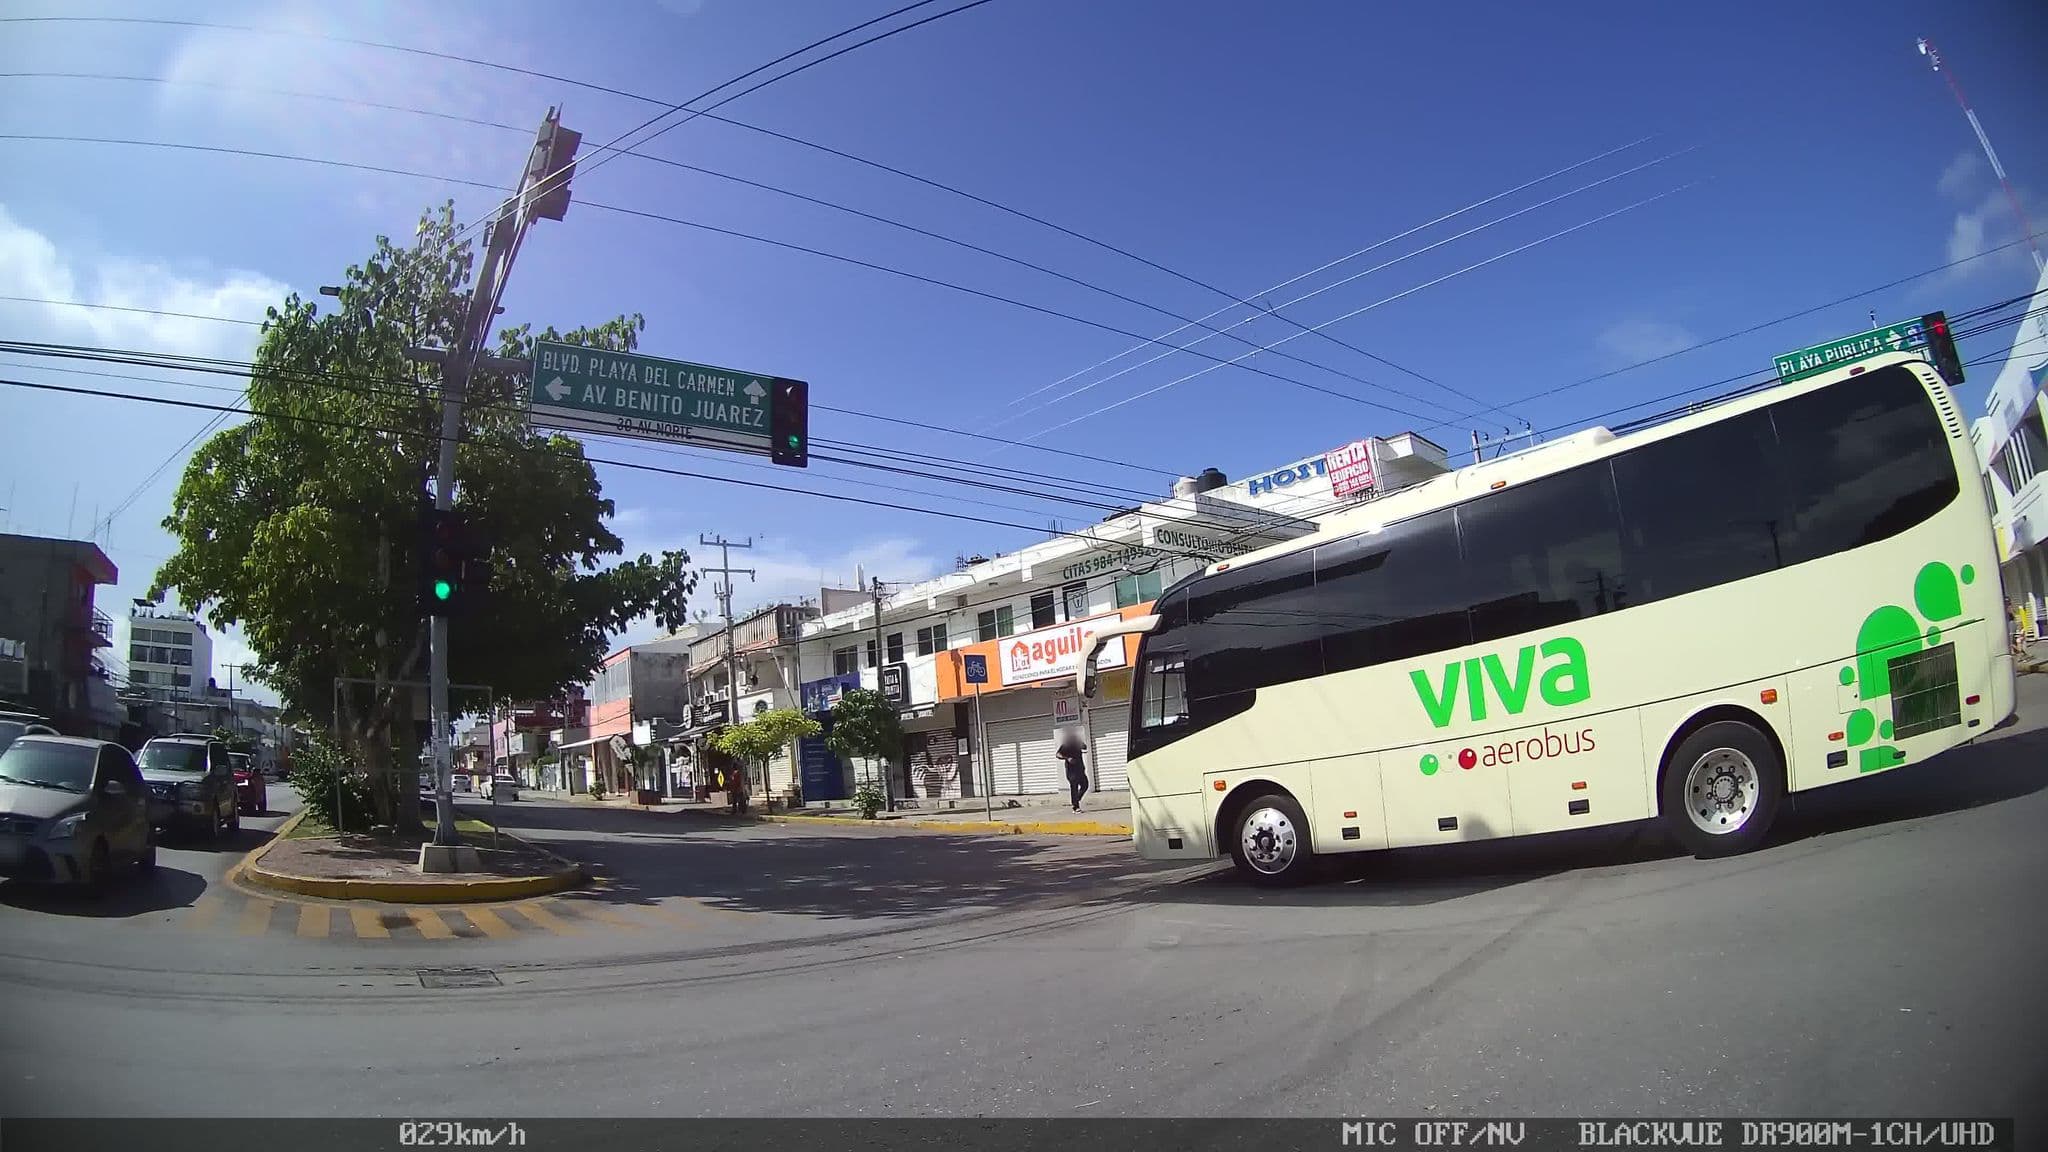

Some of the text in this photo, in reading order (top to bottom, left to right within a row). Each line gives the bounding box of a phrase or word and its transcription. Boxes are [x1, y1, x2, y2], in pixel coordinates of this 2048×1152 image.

[542, 351, 735, 397] BLVD. PLAYA DEL CARMEN
[1780, 354, 1822, 376] PLAYA
[583, 384, 765, 428] AV. BENITO JUAREZ
[637, 421, 652, 434] AV
[656, 423, 693, 439] NORTE
[1327, 442, 1367, 471] RENTA
[1249, 458, 1327, 496] HOST
[1330, 461, 1370, 484] EDIFICIO
[1063, 560, 1092, 580] CITAS
[1482, 727, 1596, 767] aerobus
